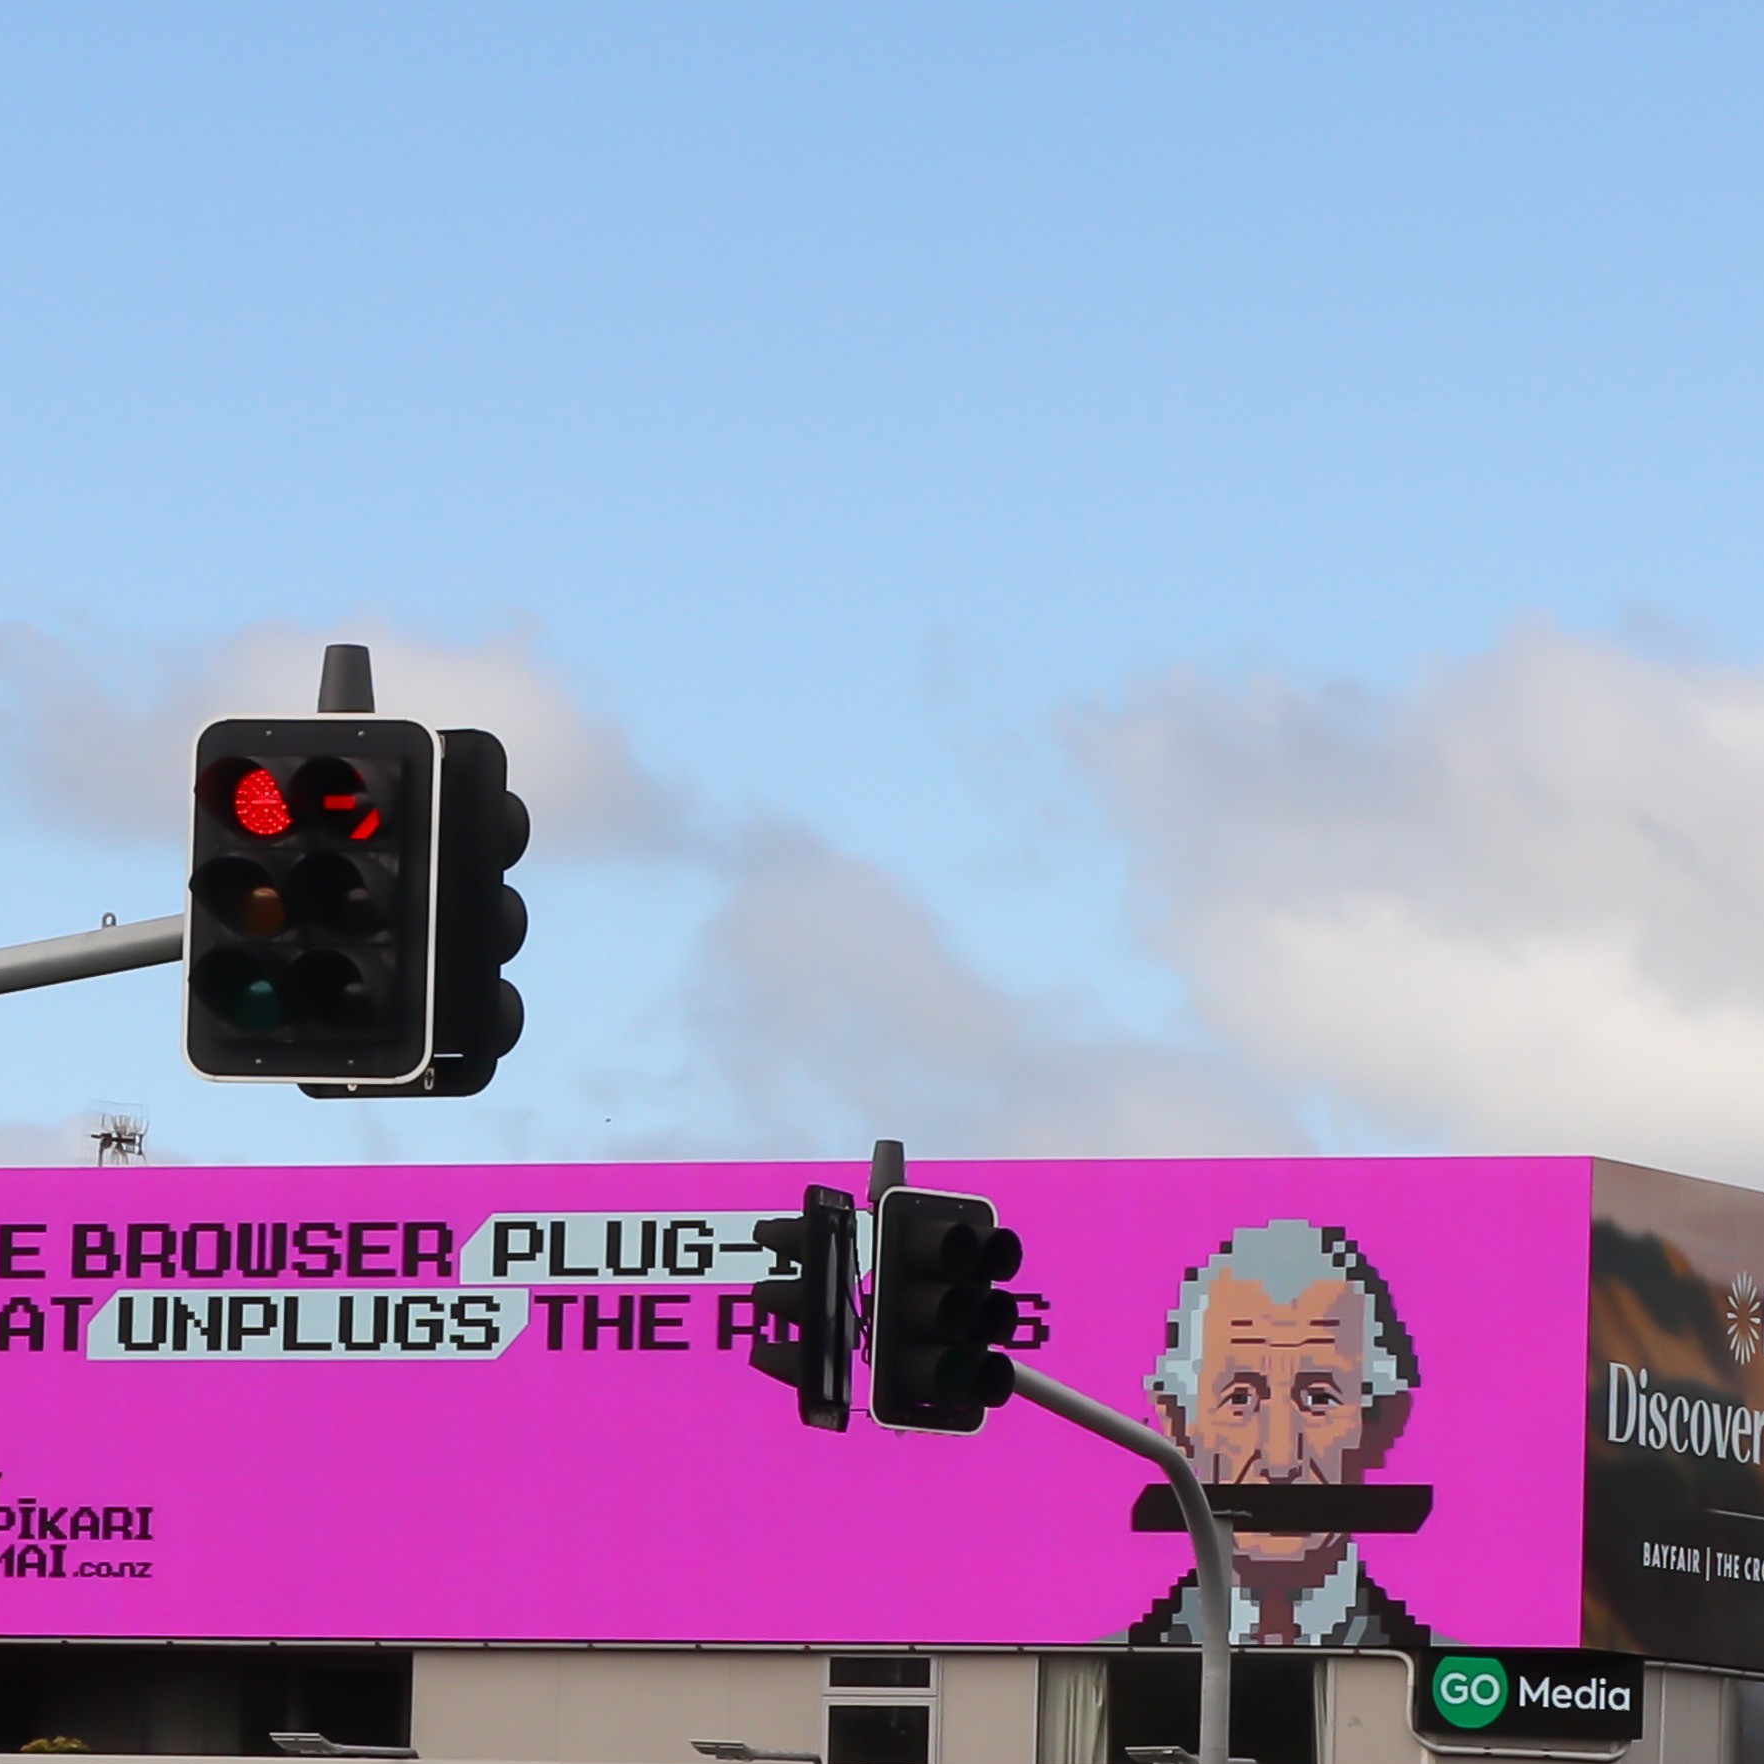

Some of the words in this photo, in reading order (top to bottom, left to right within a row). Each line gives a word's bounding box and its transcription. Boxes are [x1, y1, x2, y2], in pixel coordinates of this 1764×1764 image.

[72, 1222, 453, 1279] BROWSER
[117, 1295, 501, 1352] UNPLUGS
[534, 1294, 691, 1351] THE
[1642, 1541, 1702, 1575] BAYFAIR
[1715, 1551, 1741, 1581] THE
[1438, 1671, 1502, 1706] GO
[1518, 1676, 1632, 1712] Media
